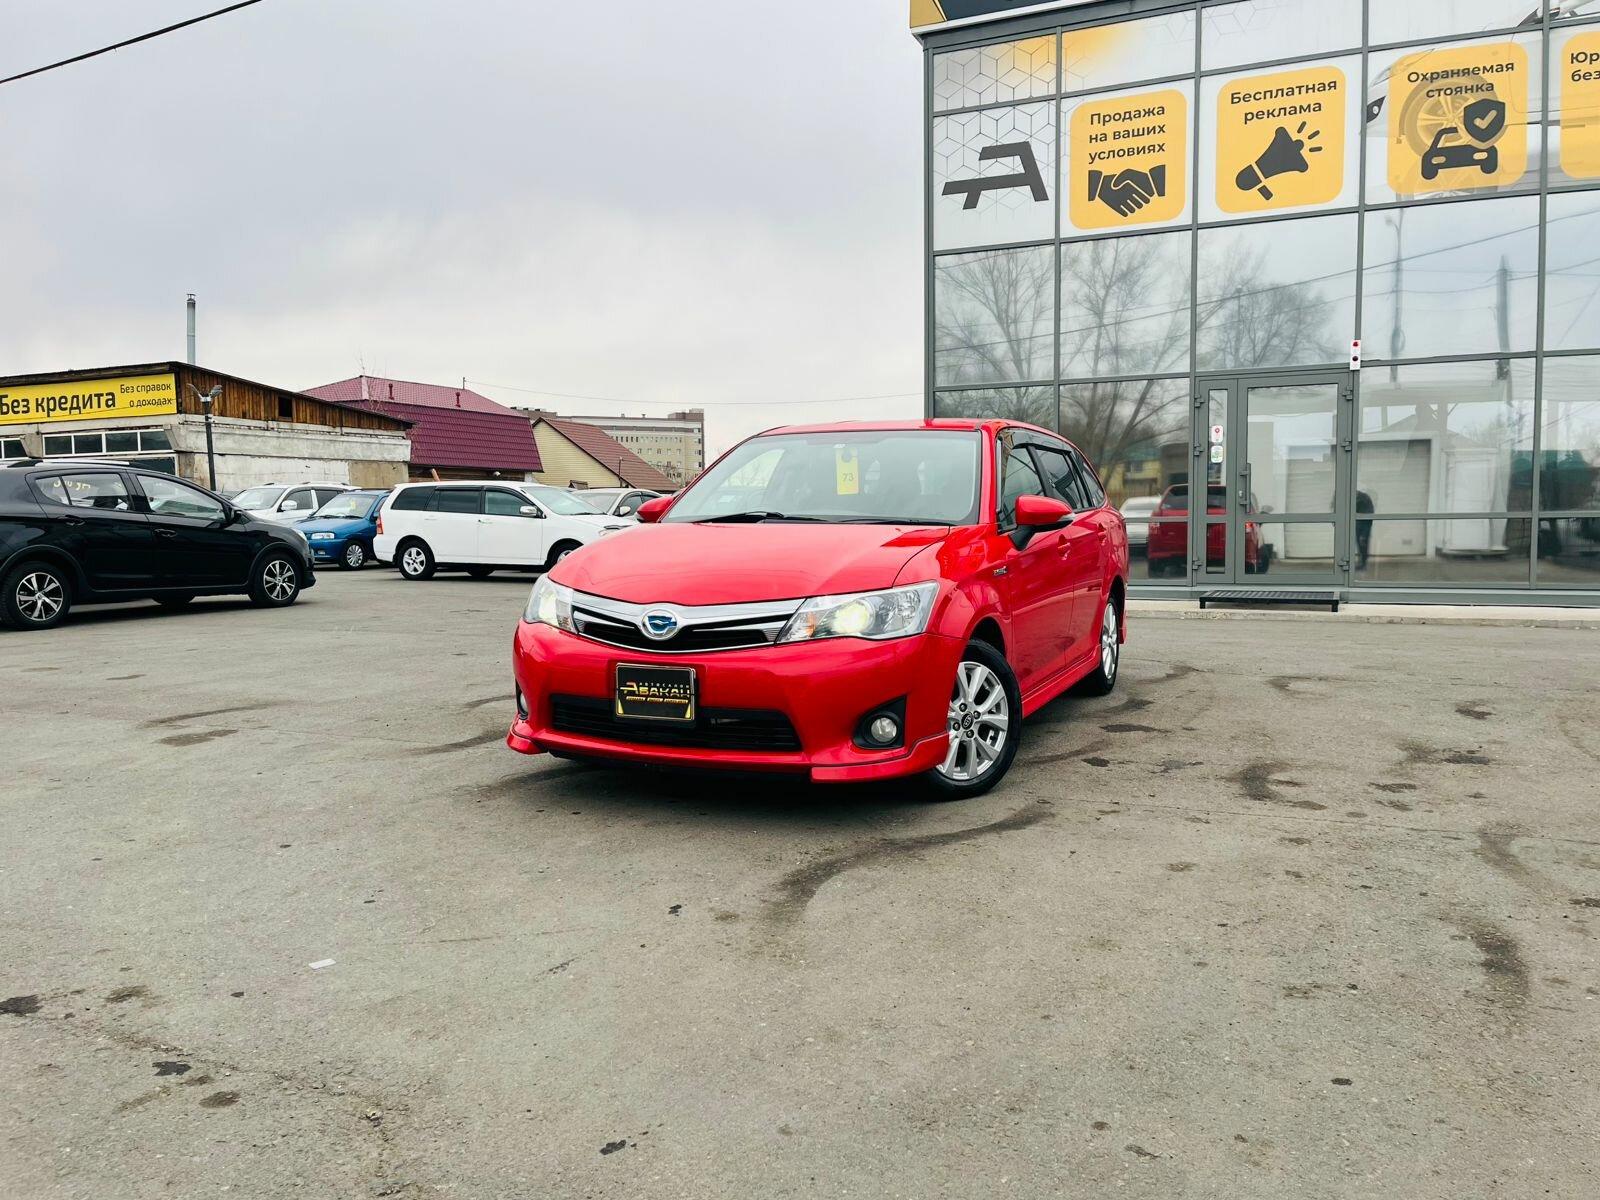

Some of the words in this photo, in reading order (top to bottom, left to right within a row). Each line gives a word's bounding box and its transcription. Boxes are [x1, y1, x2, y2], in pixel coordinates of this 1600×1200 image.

[1571, 51, 1600, 65] Юр
[1407, 62, 1515, 83] Охраняемая
[1230, 80, 1337, 105] Бесплатная
[1426, 82, 1495, 99] стоянка
[1090, 105, 1165, 126] Продажа
[1244, 102, 1322, 125] реклама
[1089, 132, 1108, 144] на
[1113, 123, 1166, 140] ваших
[1088, 142, 1166, 165] условиях
[120, 384, 136, 394] Без
[136, 383, 172, 393] справок
[0, 394, 31, 416] Без
[35, 391, 116, 418] кредита
[136, 399, 173, 408] доходах
